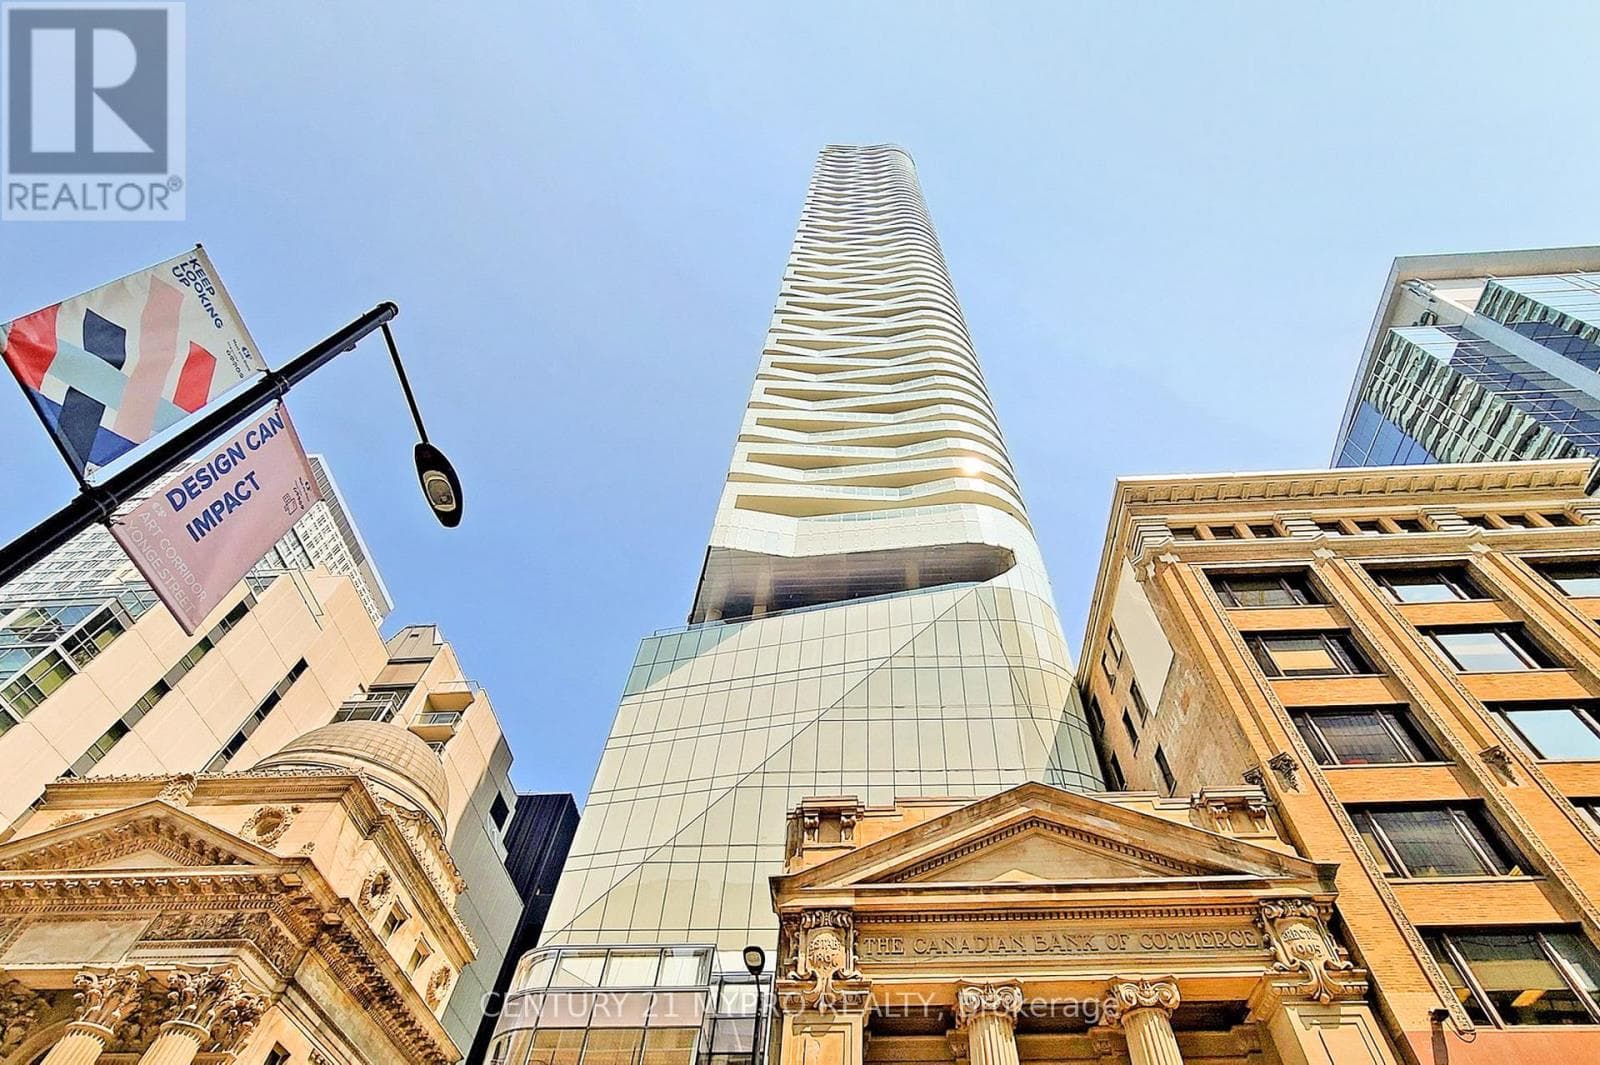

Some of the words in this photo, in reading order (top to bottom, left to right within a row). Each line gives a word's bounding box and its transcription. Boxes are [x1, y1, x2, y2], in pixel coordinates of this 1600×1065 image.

[172, 266, 191, 288] UP
[179, 262, 223, 329] LOOKING
[189, 258, 215, 296] KEEP
[165, 441, 246, 512] DESIGN
[245, 412, 284, 451] CAN
[185, 471, 260, 543] IMPACT
[129, 519, 163, 569] YONGE
[160, 568, 197, 614] STREET
[141, 512, 164, 537] ART
[160, 538, 208, 601] CORRIDOR
[863, 937, 905, 955] THE
[913, 935, 1028, 955] CANADIAN
[1035, 933, 1098, 953] BANK
[1105, 932, 1129, 951] OF
[1140, 929, 1259, 950] COMMERCE
